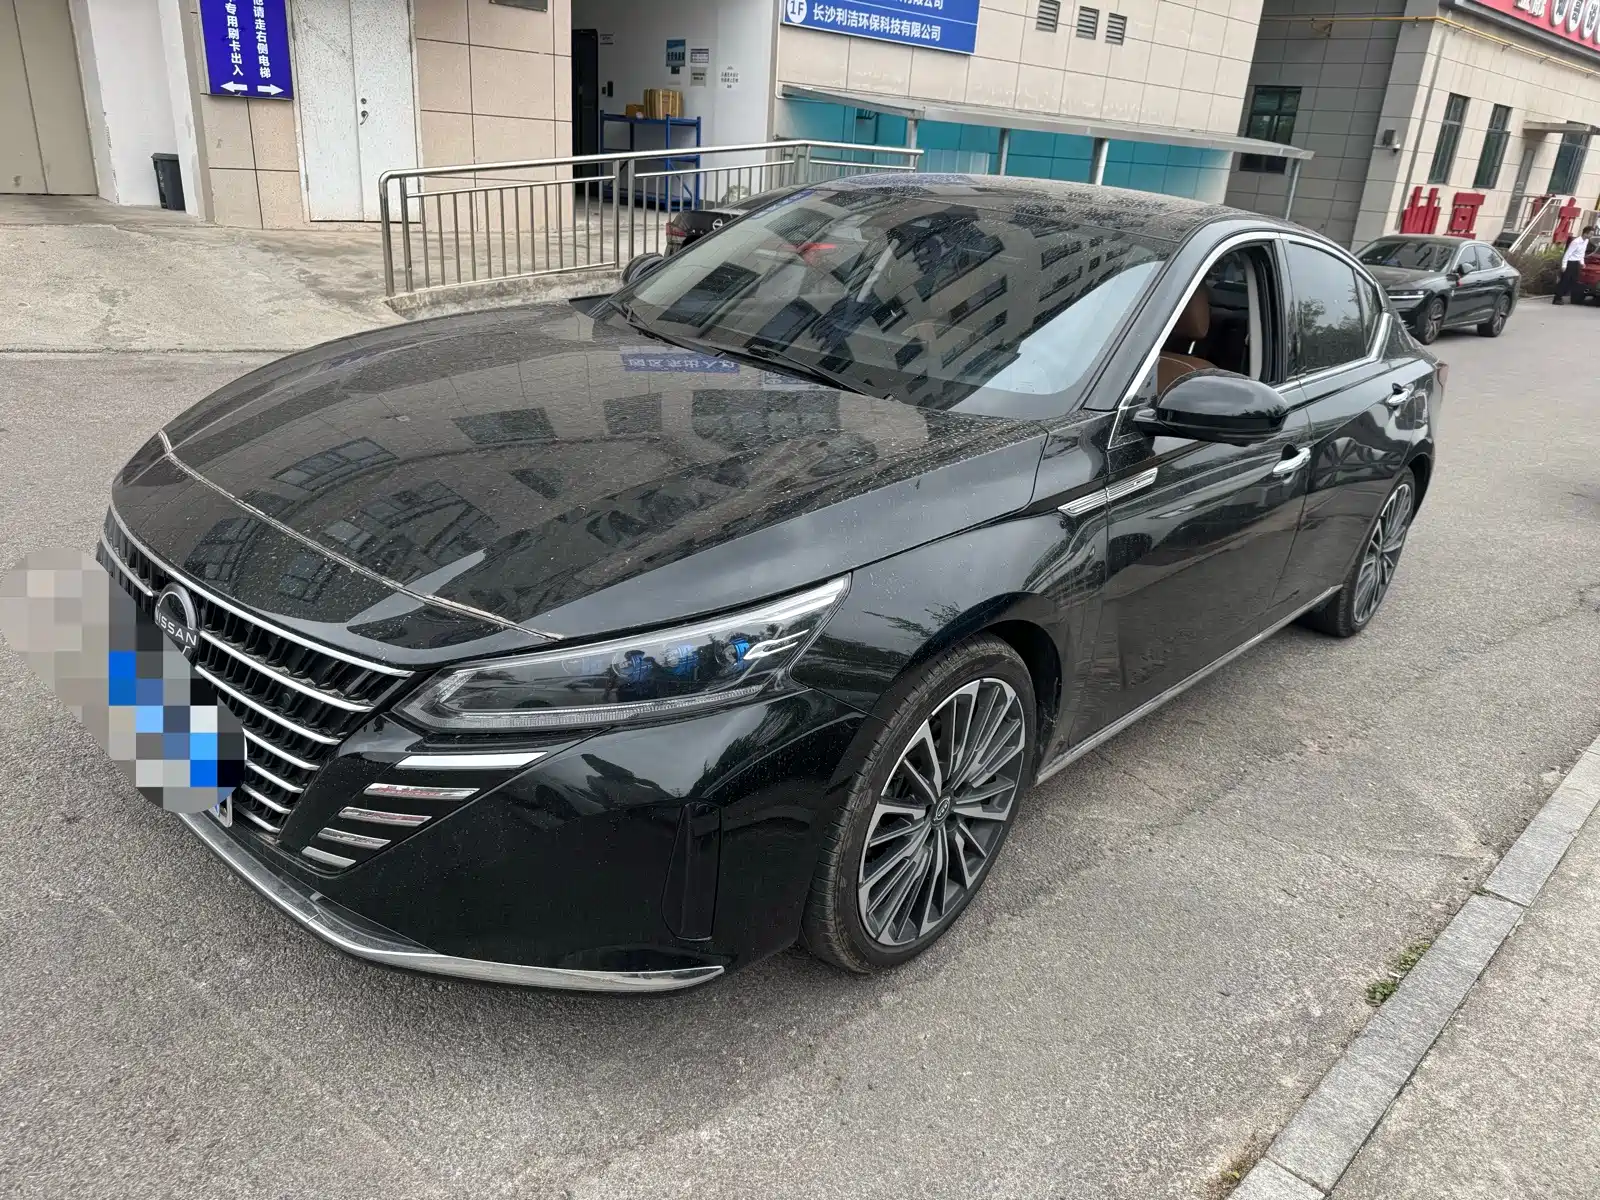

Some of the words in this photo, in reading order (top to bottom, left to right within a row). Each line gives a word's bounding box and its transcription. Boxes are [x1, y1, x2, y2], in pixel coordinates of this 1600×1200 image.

[790, 1, 804, 15] 1F
[902, 0, 943, 10] 公司
[813, 4, 941, 41] 长沙利洁环保科技有限公司
[225, 0, 243, 76] 专用刷卡出入
